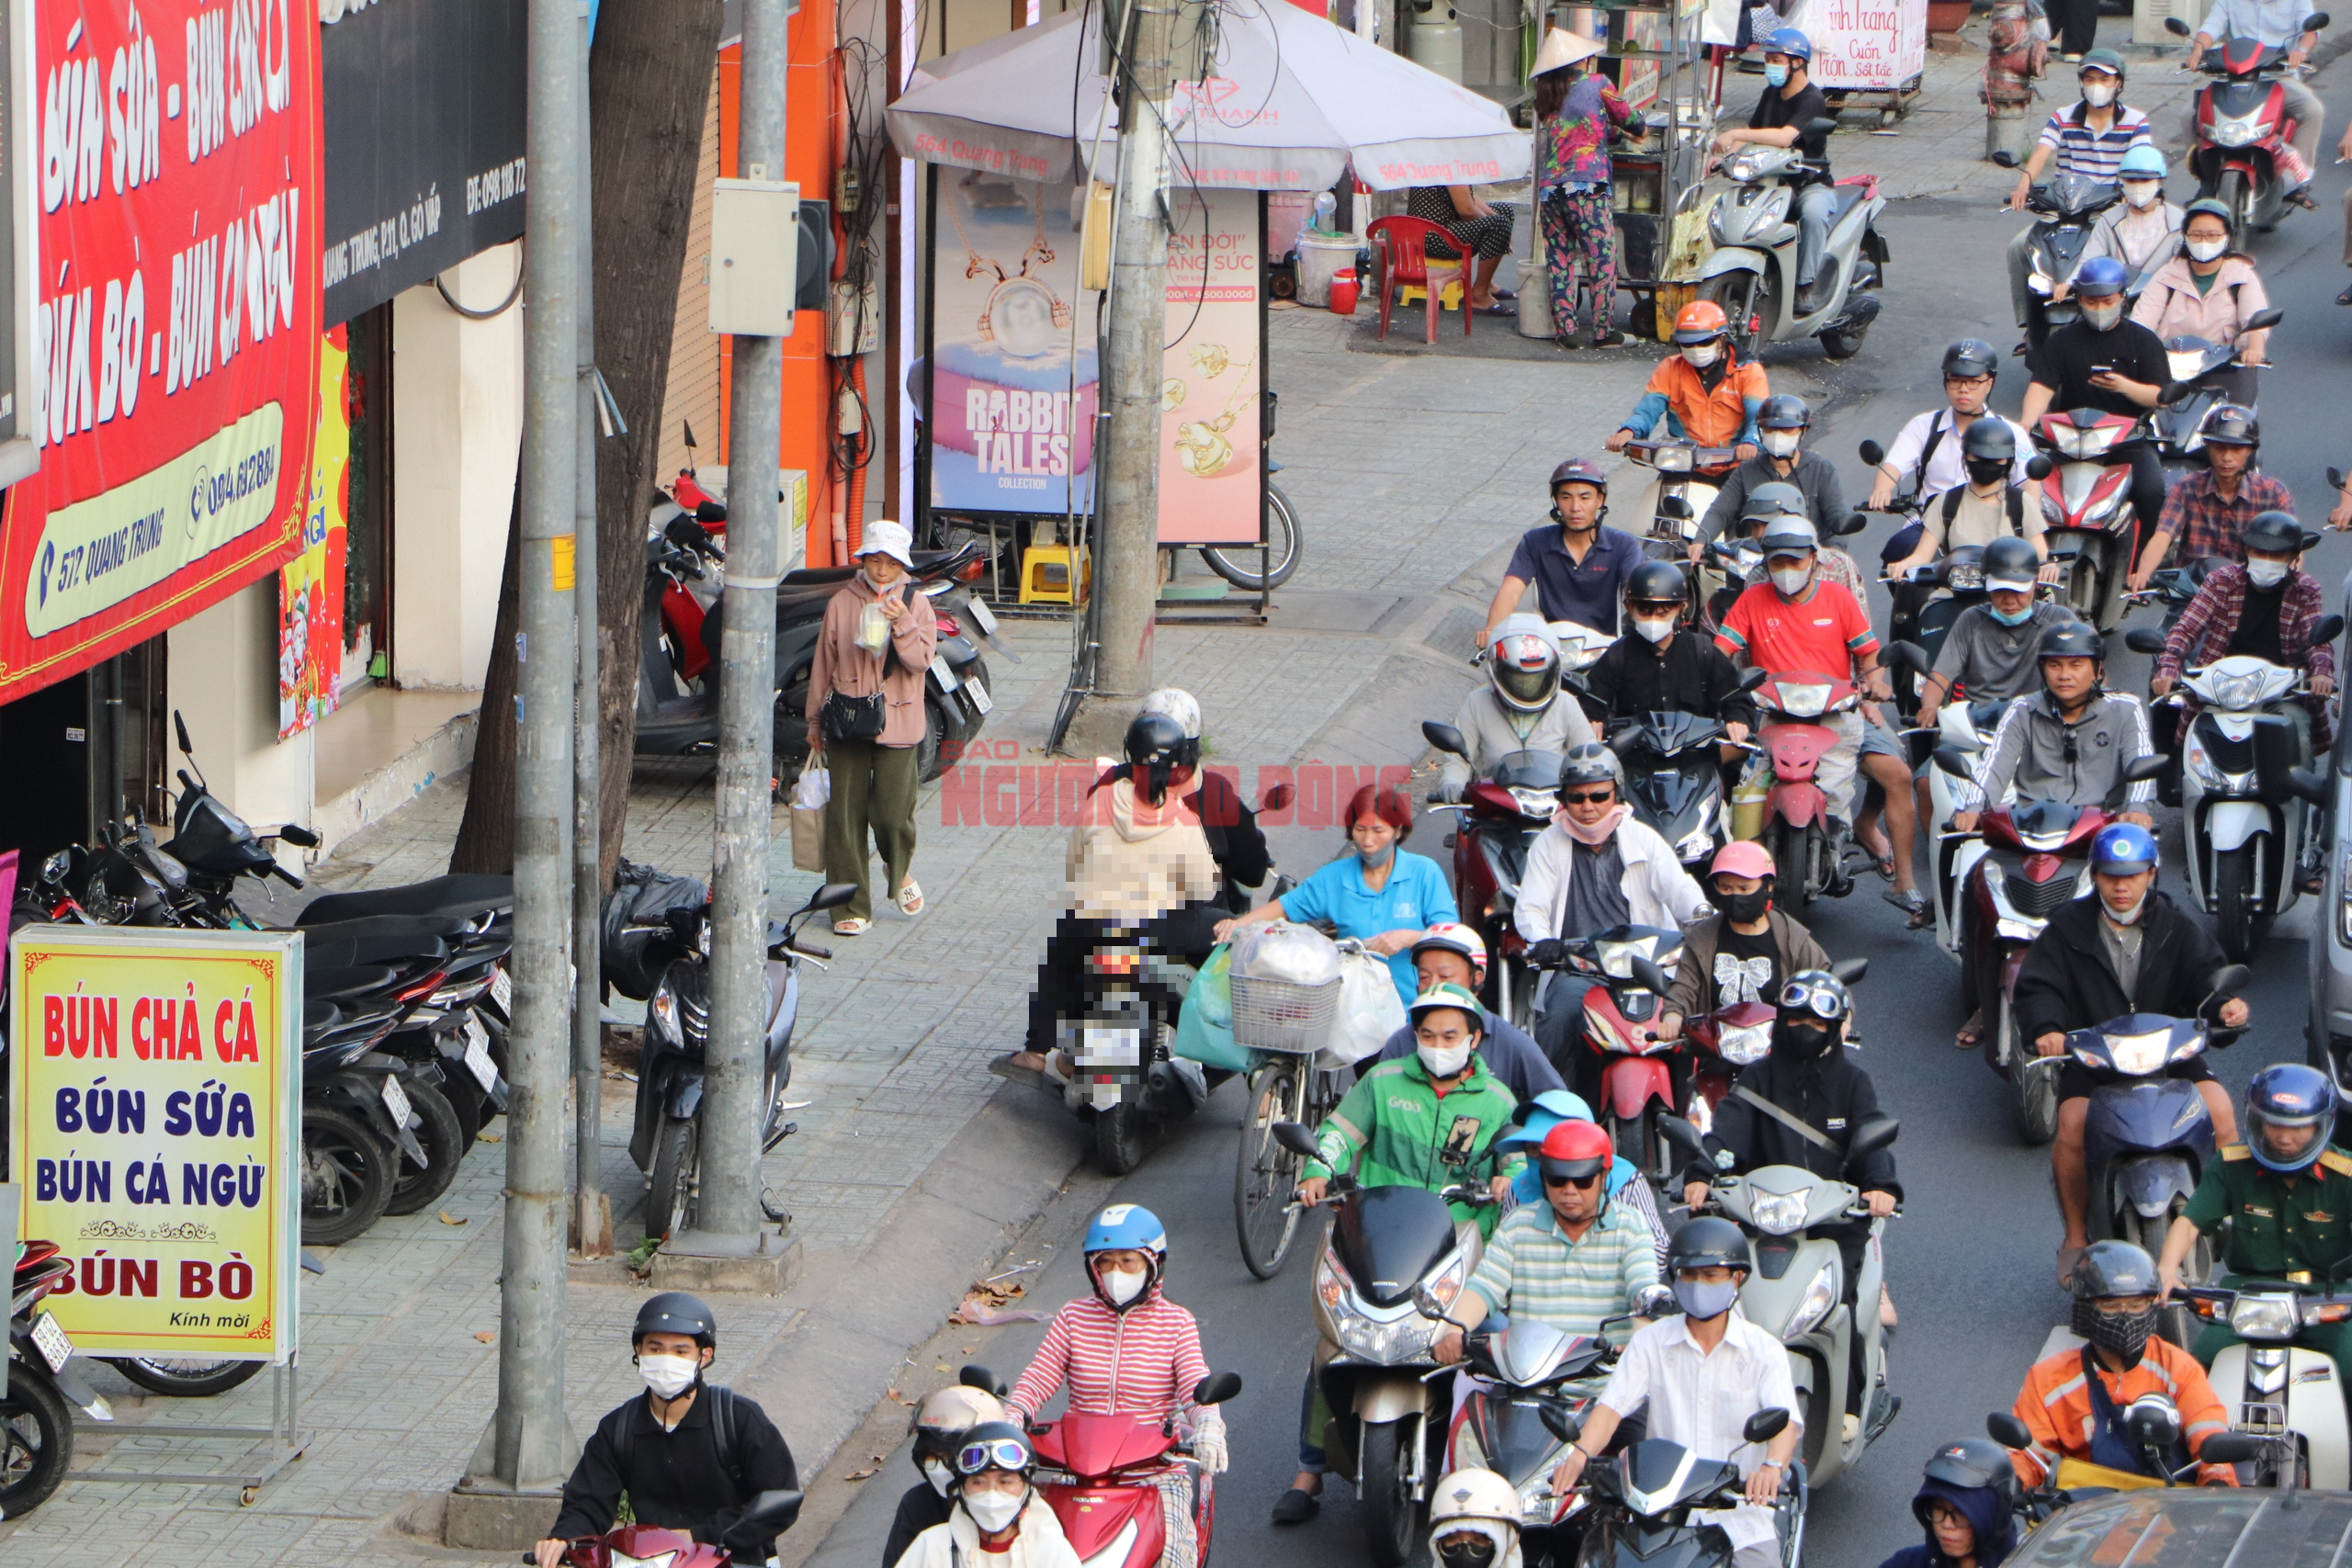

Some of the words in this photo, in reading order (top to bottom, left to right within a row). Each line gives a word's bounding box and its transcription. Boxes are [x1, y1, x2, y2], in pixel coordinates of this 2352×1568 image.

[1849, 38, 1881, 60] Cuốn
[1194, 107, 1279, 120] THANH
[913, 133, 947, 154] 564
[952, 140, 1004, 169] Quang
[1009, 149, 1049, 177] Trung
[1379, 163, 1407, 183] 564
[1453, 159, 1500, 178] Trung
[481, 168, 501, 209] 098
[1215, 252, 1254, 270] SỨC
[166, 209, 219, 396] BÚN
[967, 389, 1082, 434] RABBIT
[973, 431, 1069, 478] TALES
[998, 477, 1047, 491] COLLECTION
[44, 981, 119, 1059] BÚN
[131, 981, 204, 1062] CHẢ
[213, 986, 260, 1064] CÁ
[55, 1075, 146, 1135] BÚN
[164, 1077, 255, 1139] SỨA
[1388, 1095, 1421, 1114] Grab
[36, 1149, 111, 1203] BÚN
[125, 1153, 171, 1206] CÁ
[183, 1154, 266, 1208] NGỪ
[48, 1248, 159, 1298] BÚN
[179, 1252, 254, 1301] BÒ
[1372, 1280, 1399, 1288] HONDA
[169, 1312, 211, 1328] Kính
[216, 1313, 252, 1329] mời
